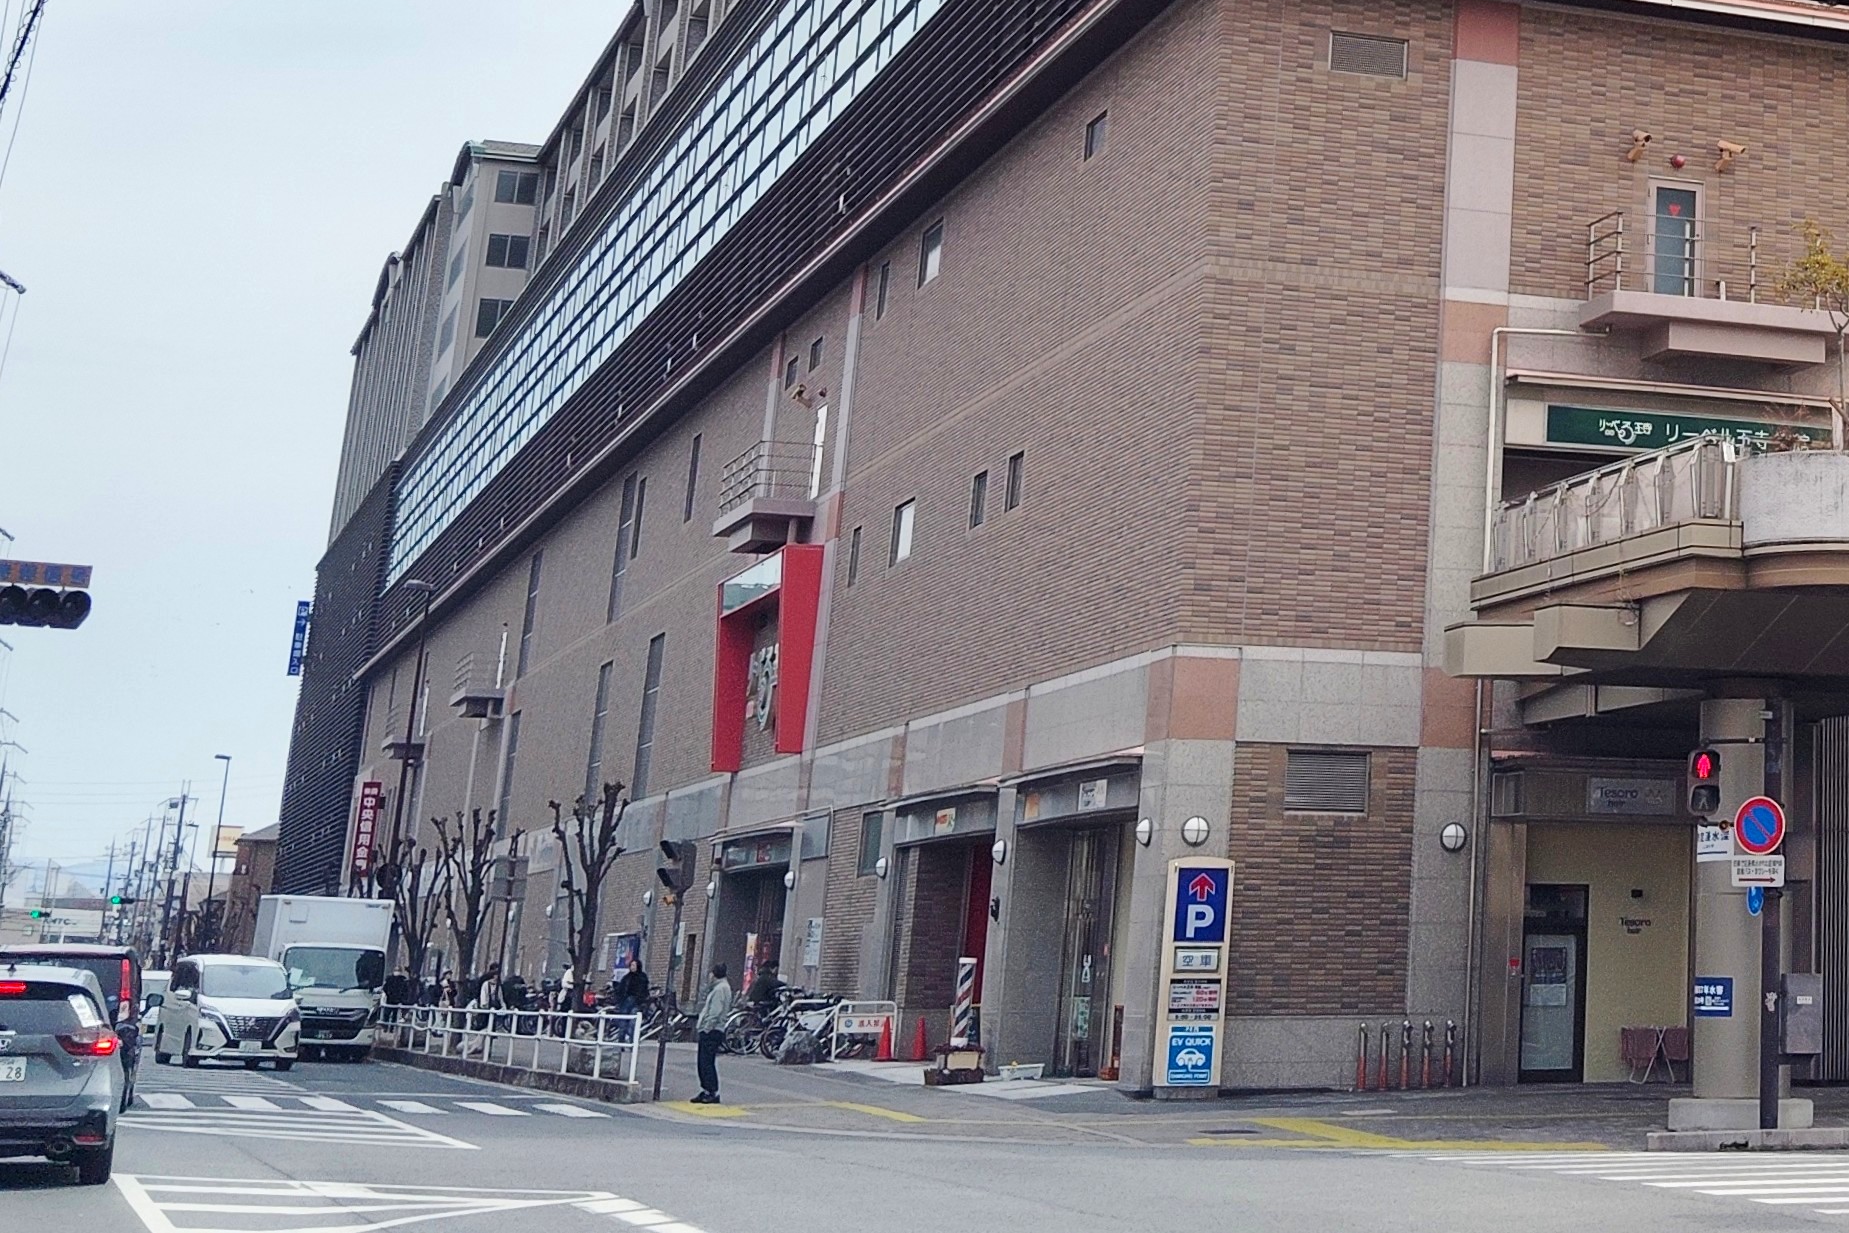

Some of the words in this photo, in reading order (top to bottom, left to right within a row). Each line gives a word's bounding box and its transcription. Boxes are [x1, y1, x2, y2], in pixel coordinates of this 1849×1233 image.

[1599, 787, 1639, 799] Tesoro
[1185, 904, 1215, 939] P
[1171, 1037, 1184, 1047] EV
[1185, 1037, 1212, 1047] QUICK
